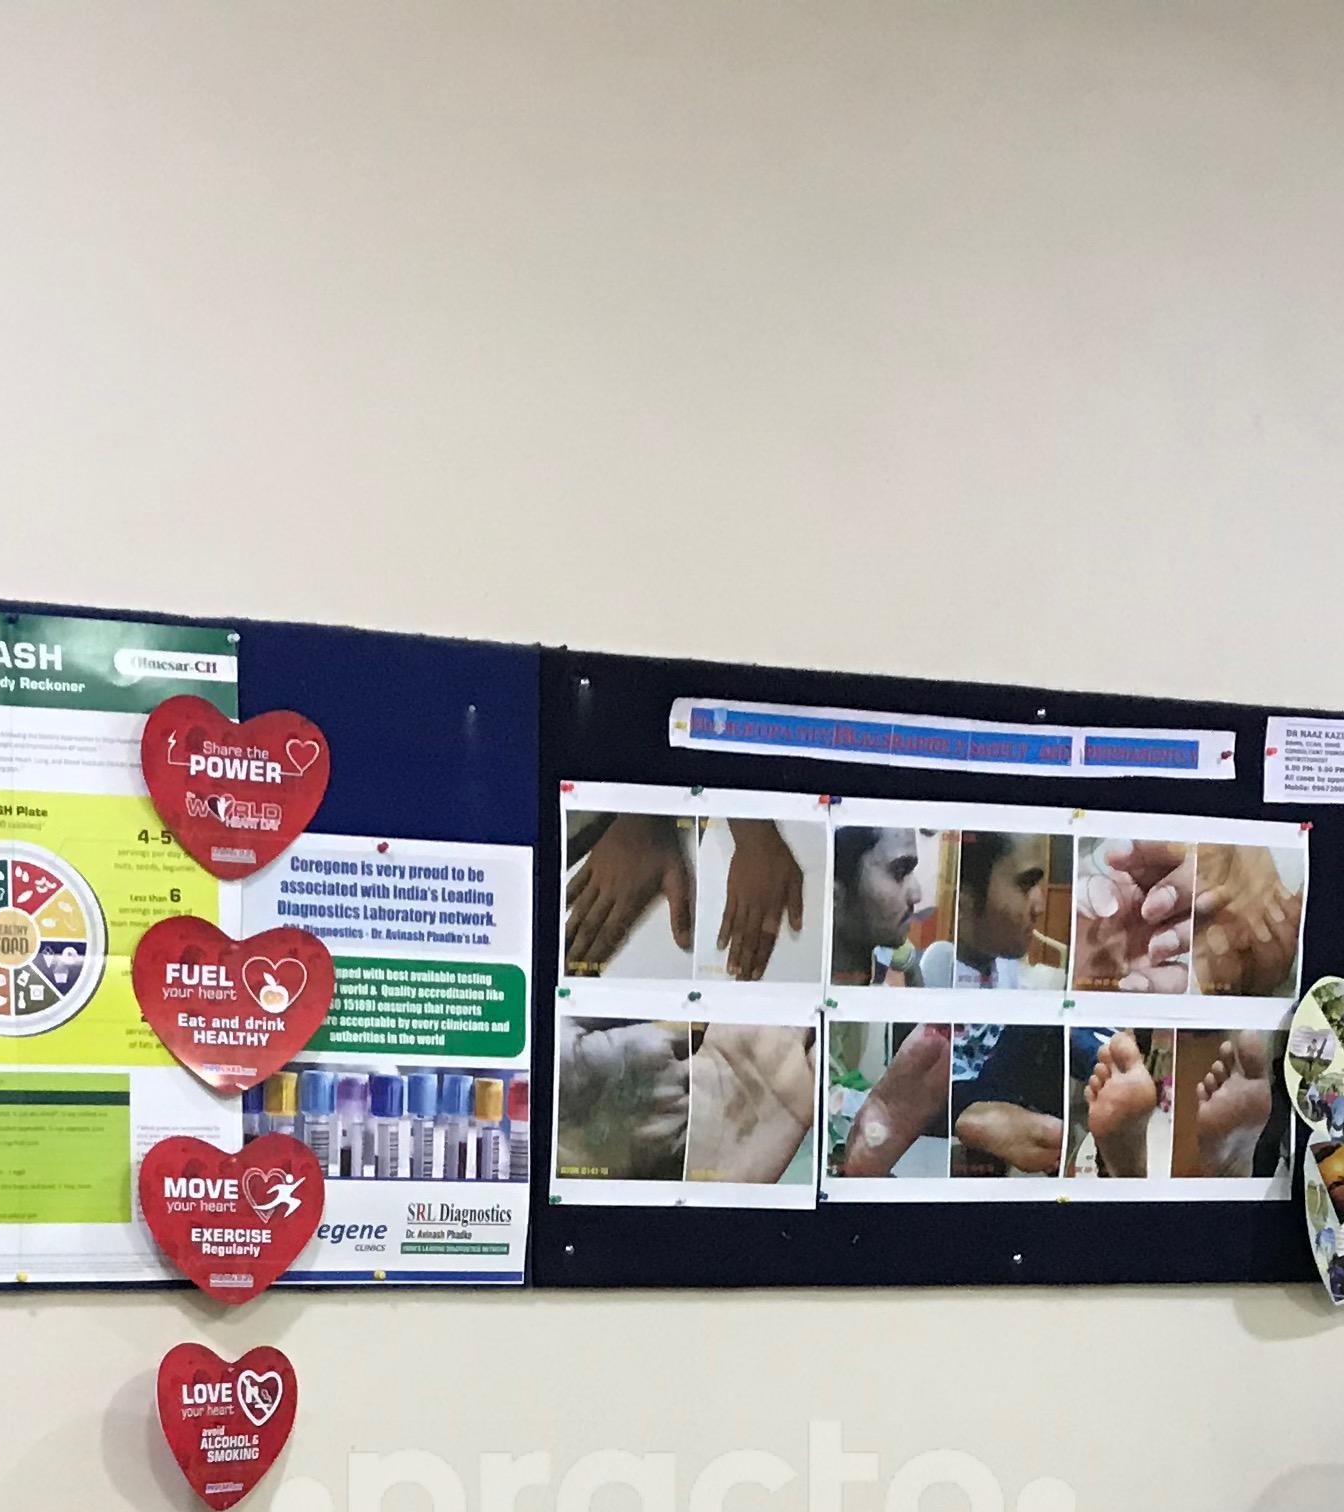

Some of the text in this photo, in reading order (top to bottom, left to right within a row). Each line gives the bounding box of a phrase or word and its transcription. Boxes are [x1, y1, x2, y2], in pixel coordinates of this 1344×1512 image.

[20, 677, 85, 692] Reckoner
[1286, 729, 1298, 737] DR
[203, 741, 269, 759] Share the
[190, 754, 282, 784] POWER
[16, 806, 49, 817] Plate
[361, 861, 373, 876] is
[376, 864, 405, 879] very
[409, 865, 448, 881] proud
[451, 867, 464, 881] to
[468, 867, 484, 882] be
[170, 888, 181, 903] 6
[280, 880, 494, 906] associated with India's Leading
[277, 900, 497, 927] Diagnostics Laboratory network.
[386, 929, 424, 942] Avinash
[427, 931, 470, 944] Phadke's
[166, 963, 234, 987] FUEL
[363, 968, 492, 986] with best available testing
[162, 987, 237, 1000] your heart
[340, 984, 504, 1001] world Quality accreditation like
[378, 1001, 482, 1016] ensuring that reports
[178, 1013, 285, 1031] Eat and drink
[340, 1016, 510, 1032] acceptable by every clinicians and
[193, 1031, 270, 1046] HEALTHY
[330, 1030, 445, 1046] authorities in the world
[164, 1177, 239, 1199] MOVE
[167, 1200, 236, 1213] your heart
[407, 1203, 512, 1227] SRL Diagnostics
[191, 1228, 271, 1243] EXERCISE
[417, 1229, 445, 1239] Avinash
[202, 1243, 260, 1257] Regularly
[355, 1244, 386, 1252] CLINICS
[182, 1383, 232, 1405] LOVE
[181, 1404, 235, 1420] your heart
[202, 1426, 225, 1437] avoid
[207, 1448, 259, 1463] SMOKING
